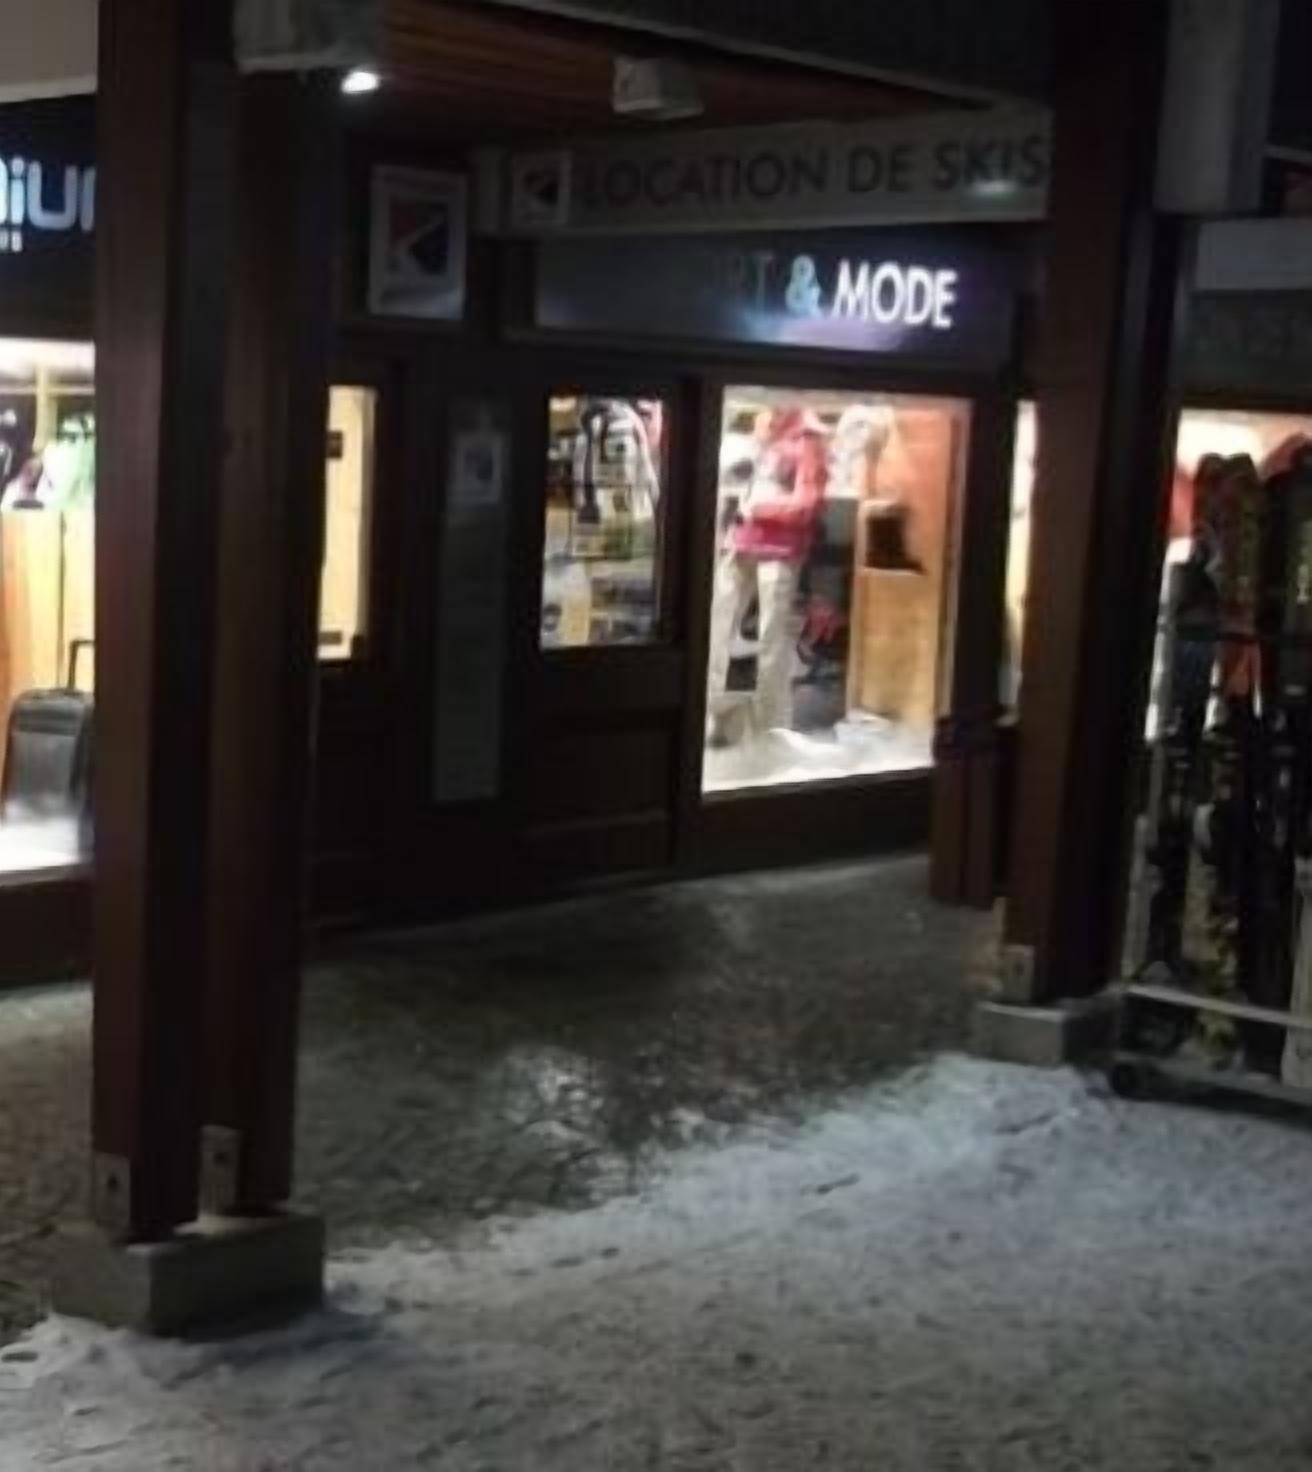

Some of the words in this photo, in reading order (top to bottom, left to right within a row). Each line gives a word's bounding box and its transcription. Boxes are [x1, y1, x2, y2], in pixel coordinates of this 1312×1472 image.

[580, 142, 829, 208] LOCATION
[848, 142, 914, 194] DE
[933, 134, 1046, 191] SKIS
[785, 254, 822, 320] &
[830, 257, 958, 329] MODE
